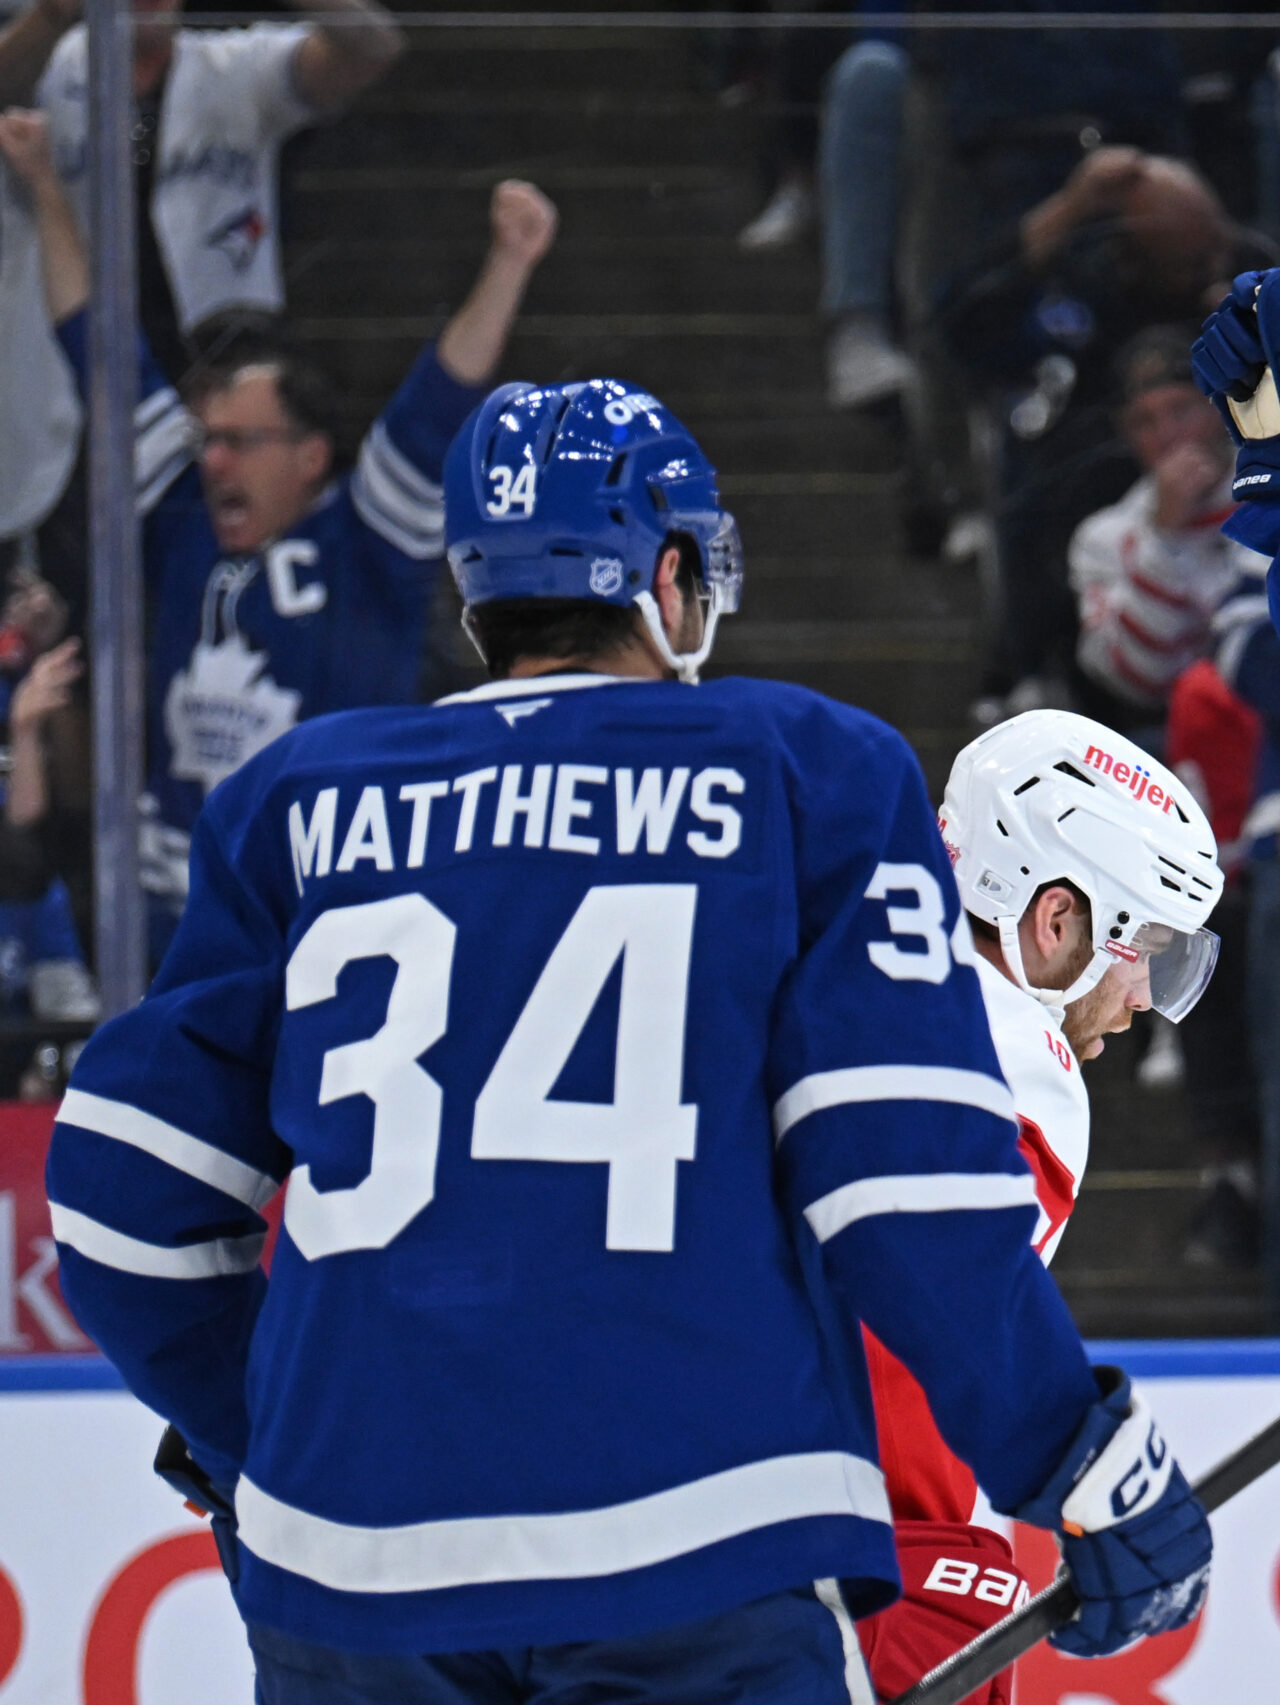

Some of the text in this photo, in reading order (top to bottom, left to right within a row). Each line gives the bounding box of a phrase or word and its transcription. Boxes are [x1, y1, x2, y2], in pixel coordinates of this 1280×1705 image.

[486, 465, 537, 516] 34
[264, 538, 328, 617] C
[1083, 744, 1177, 815] meijer
[289, 764, 744, 896] MATTHEWS
[284, 884, 698, 1262] 34
